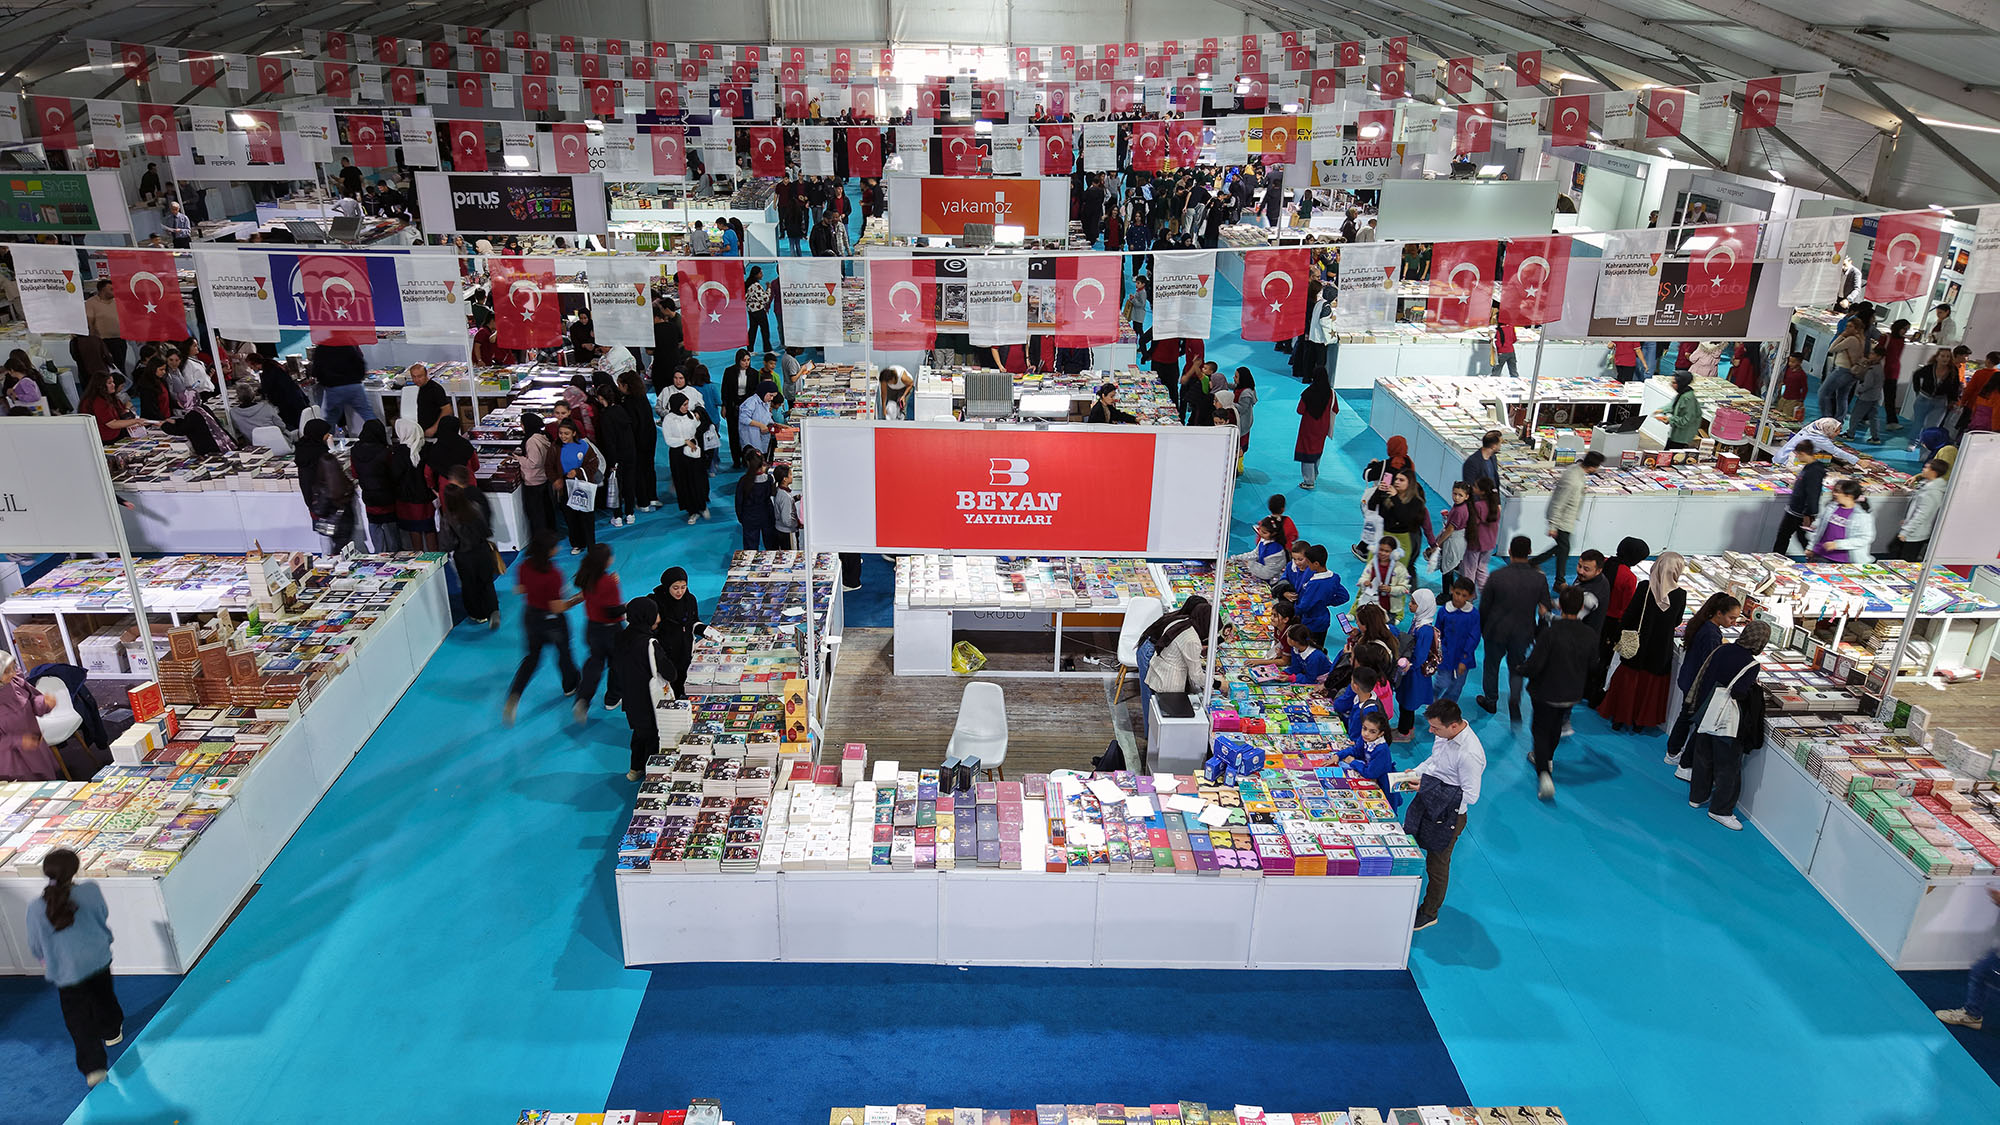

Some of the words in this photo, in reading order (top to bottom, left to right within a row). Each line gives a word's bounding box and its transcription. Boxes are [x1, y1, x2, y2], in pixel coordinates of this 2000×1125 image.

[453, 191, 500, 208] pinus
[941, 199, 1013, 216] yakamoz
[211, 284, 256, 292] Kahramanmaraş
[1155, 282, 1198, 290] Kahramanmaraş
[956, 490, 1062, 511] BEYAN
[963, 513, 1053, 525] YAYINLARI
